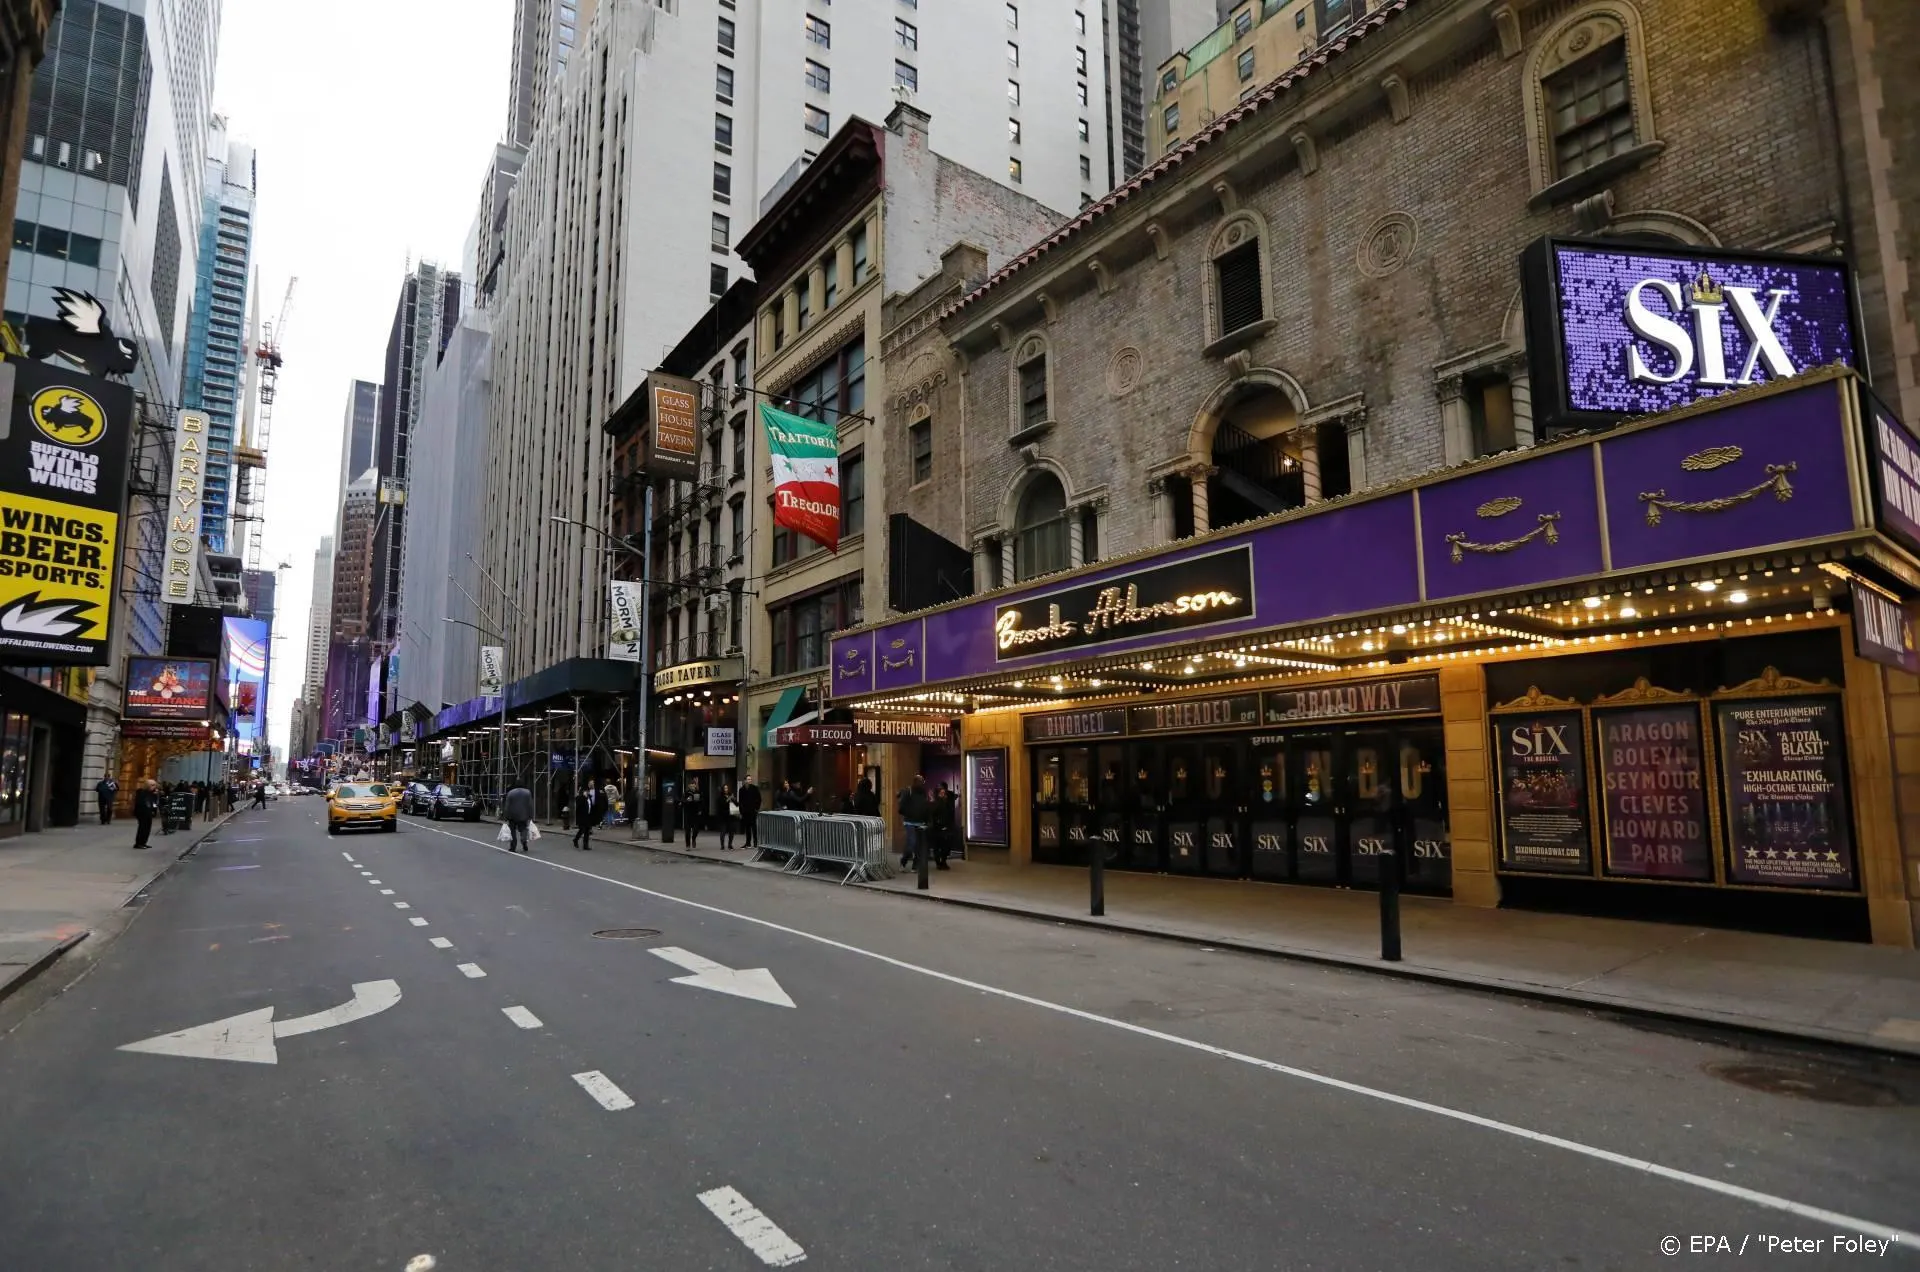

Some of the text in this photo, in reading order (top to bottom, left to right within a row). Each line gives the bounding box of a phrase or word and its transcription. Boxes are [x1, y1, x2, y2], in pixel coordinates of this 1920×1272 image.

[662, 395, 690, 409] GLASS
[660, 413, 694, 428] HOUSE
[658, 431, 695, 448] TAVERN
[768, 426, 837, 450] TRATTORIA
[31, 440, 99, 466] BUFFALO
[29, 451, 98, 481] WILD
[28, 467, 97, 495] WINGS
[168, 415, 204, 598] BARRYMORE
[1, 506, 109, 545] WINGS.
[0, 530, 107, 571] BEER.
[0, 559, 105, 590] SPORTS.
[995, 603, 1077, 649] Brooks
[656, 665, 719, 687] HOUSE TAVERN
[1296, 684, 1401, 712] BROADWAY
[1156, 700, 1231, 727] BEHEADED
[1730, 706, 1827, 720] "PURE ENTERTAINMENT!"
[854, 719, 880, 734] "PURE
[1047, 712, 1104, 736] DIVORCED
[1608, 721, 1689, 742] ARAGON
[1791, 730, 1821, 742] TOTAL
[1612, 746, 1688, 766] BOLEYN
[1607, 770, 1700, 790] SEYMOUR
[1743, 784, 1796, 793] HIGH-OCTANE
[1620, 795, 1689, 815] CLEVES
[1613, 820, 1700, 839] HOWARD
[1515, 846, 1580, 857] SIXONBROADWAY.COM
[1631, 844, 1683, 864] PARR
